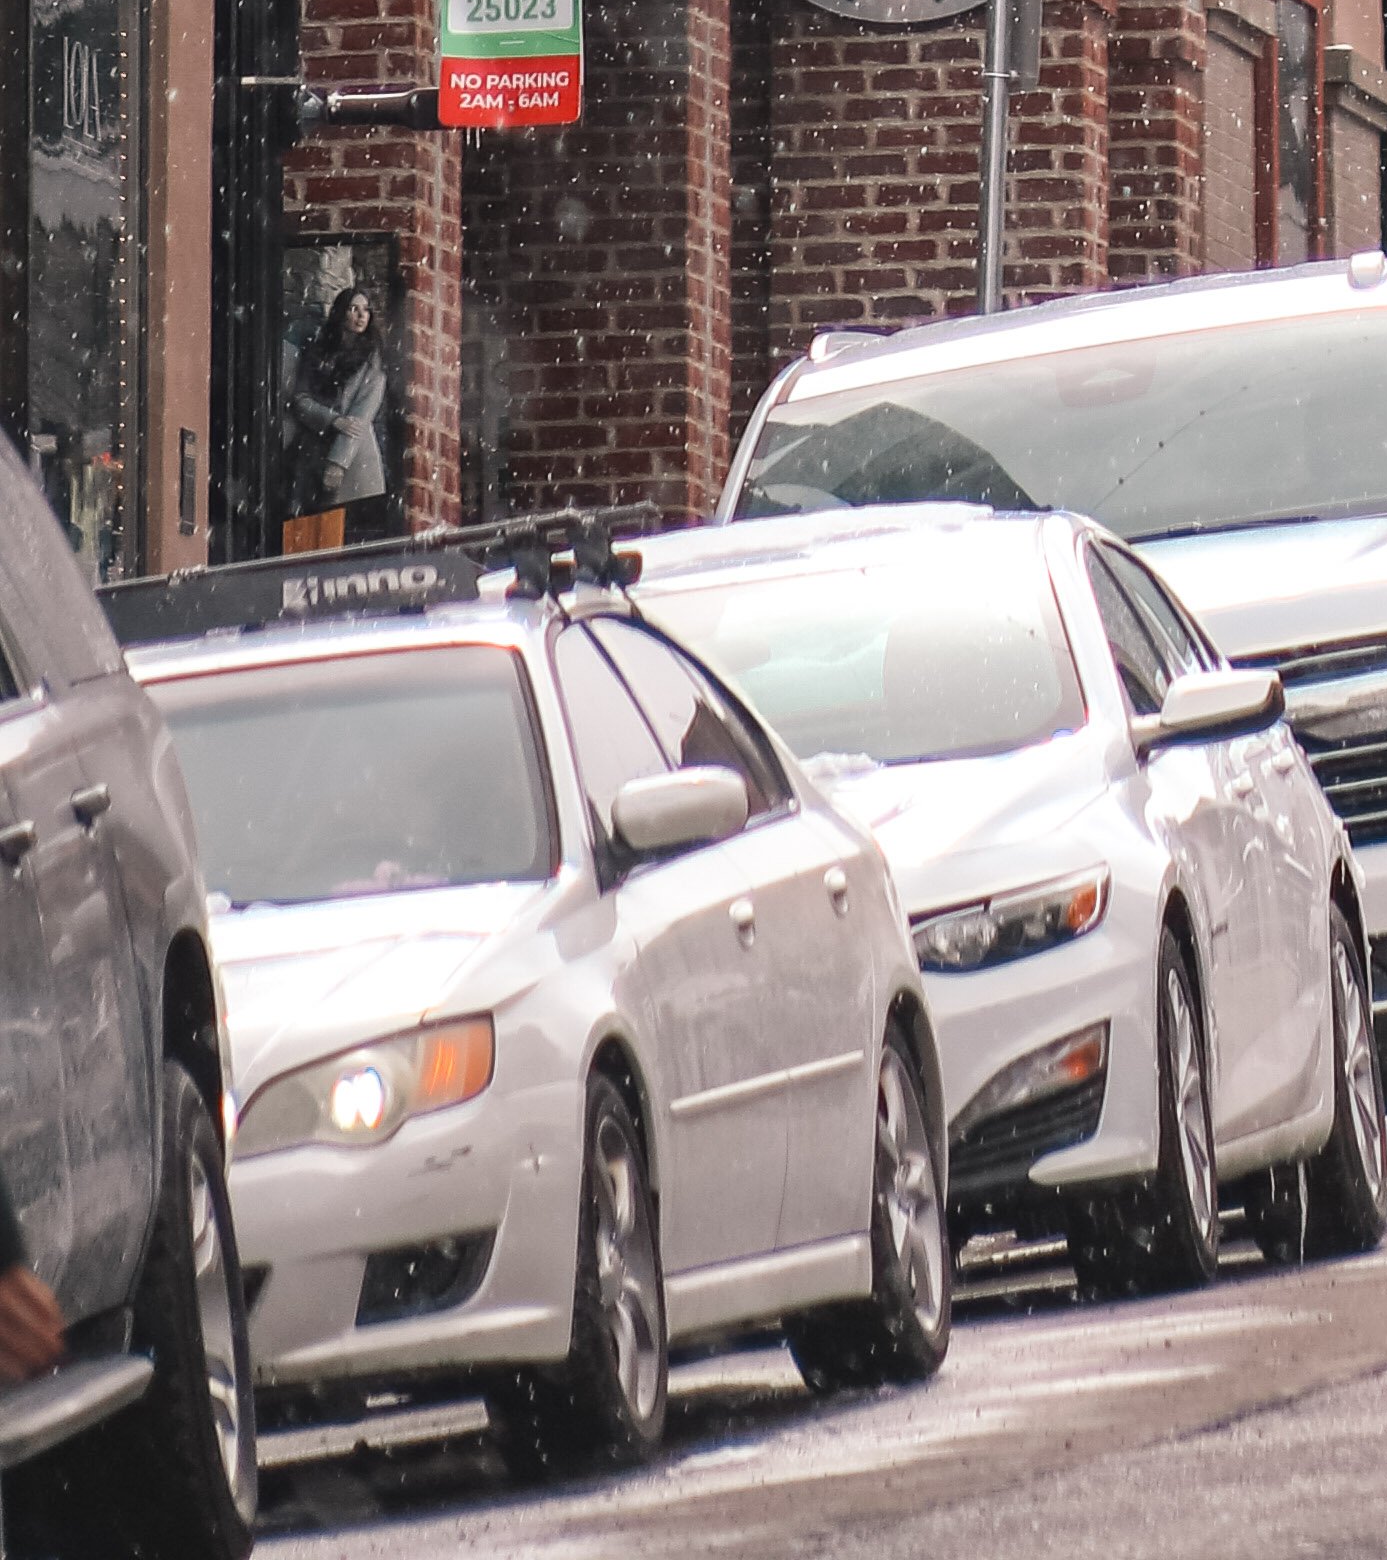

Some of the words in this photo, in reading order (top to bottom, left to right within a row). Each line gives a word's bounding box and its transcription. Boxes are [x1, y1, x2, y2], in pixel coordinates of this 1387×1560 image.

[451, 74, 482, 89] NO
[486, 71, 570, 89] PARKING
[459, 93, 503, 109] 2AM
[518, 91, 559, 107] 6AM
